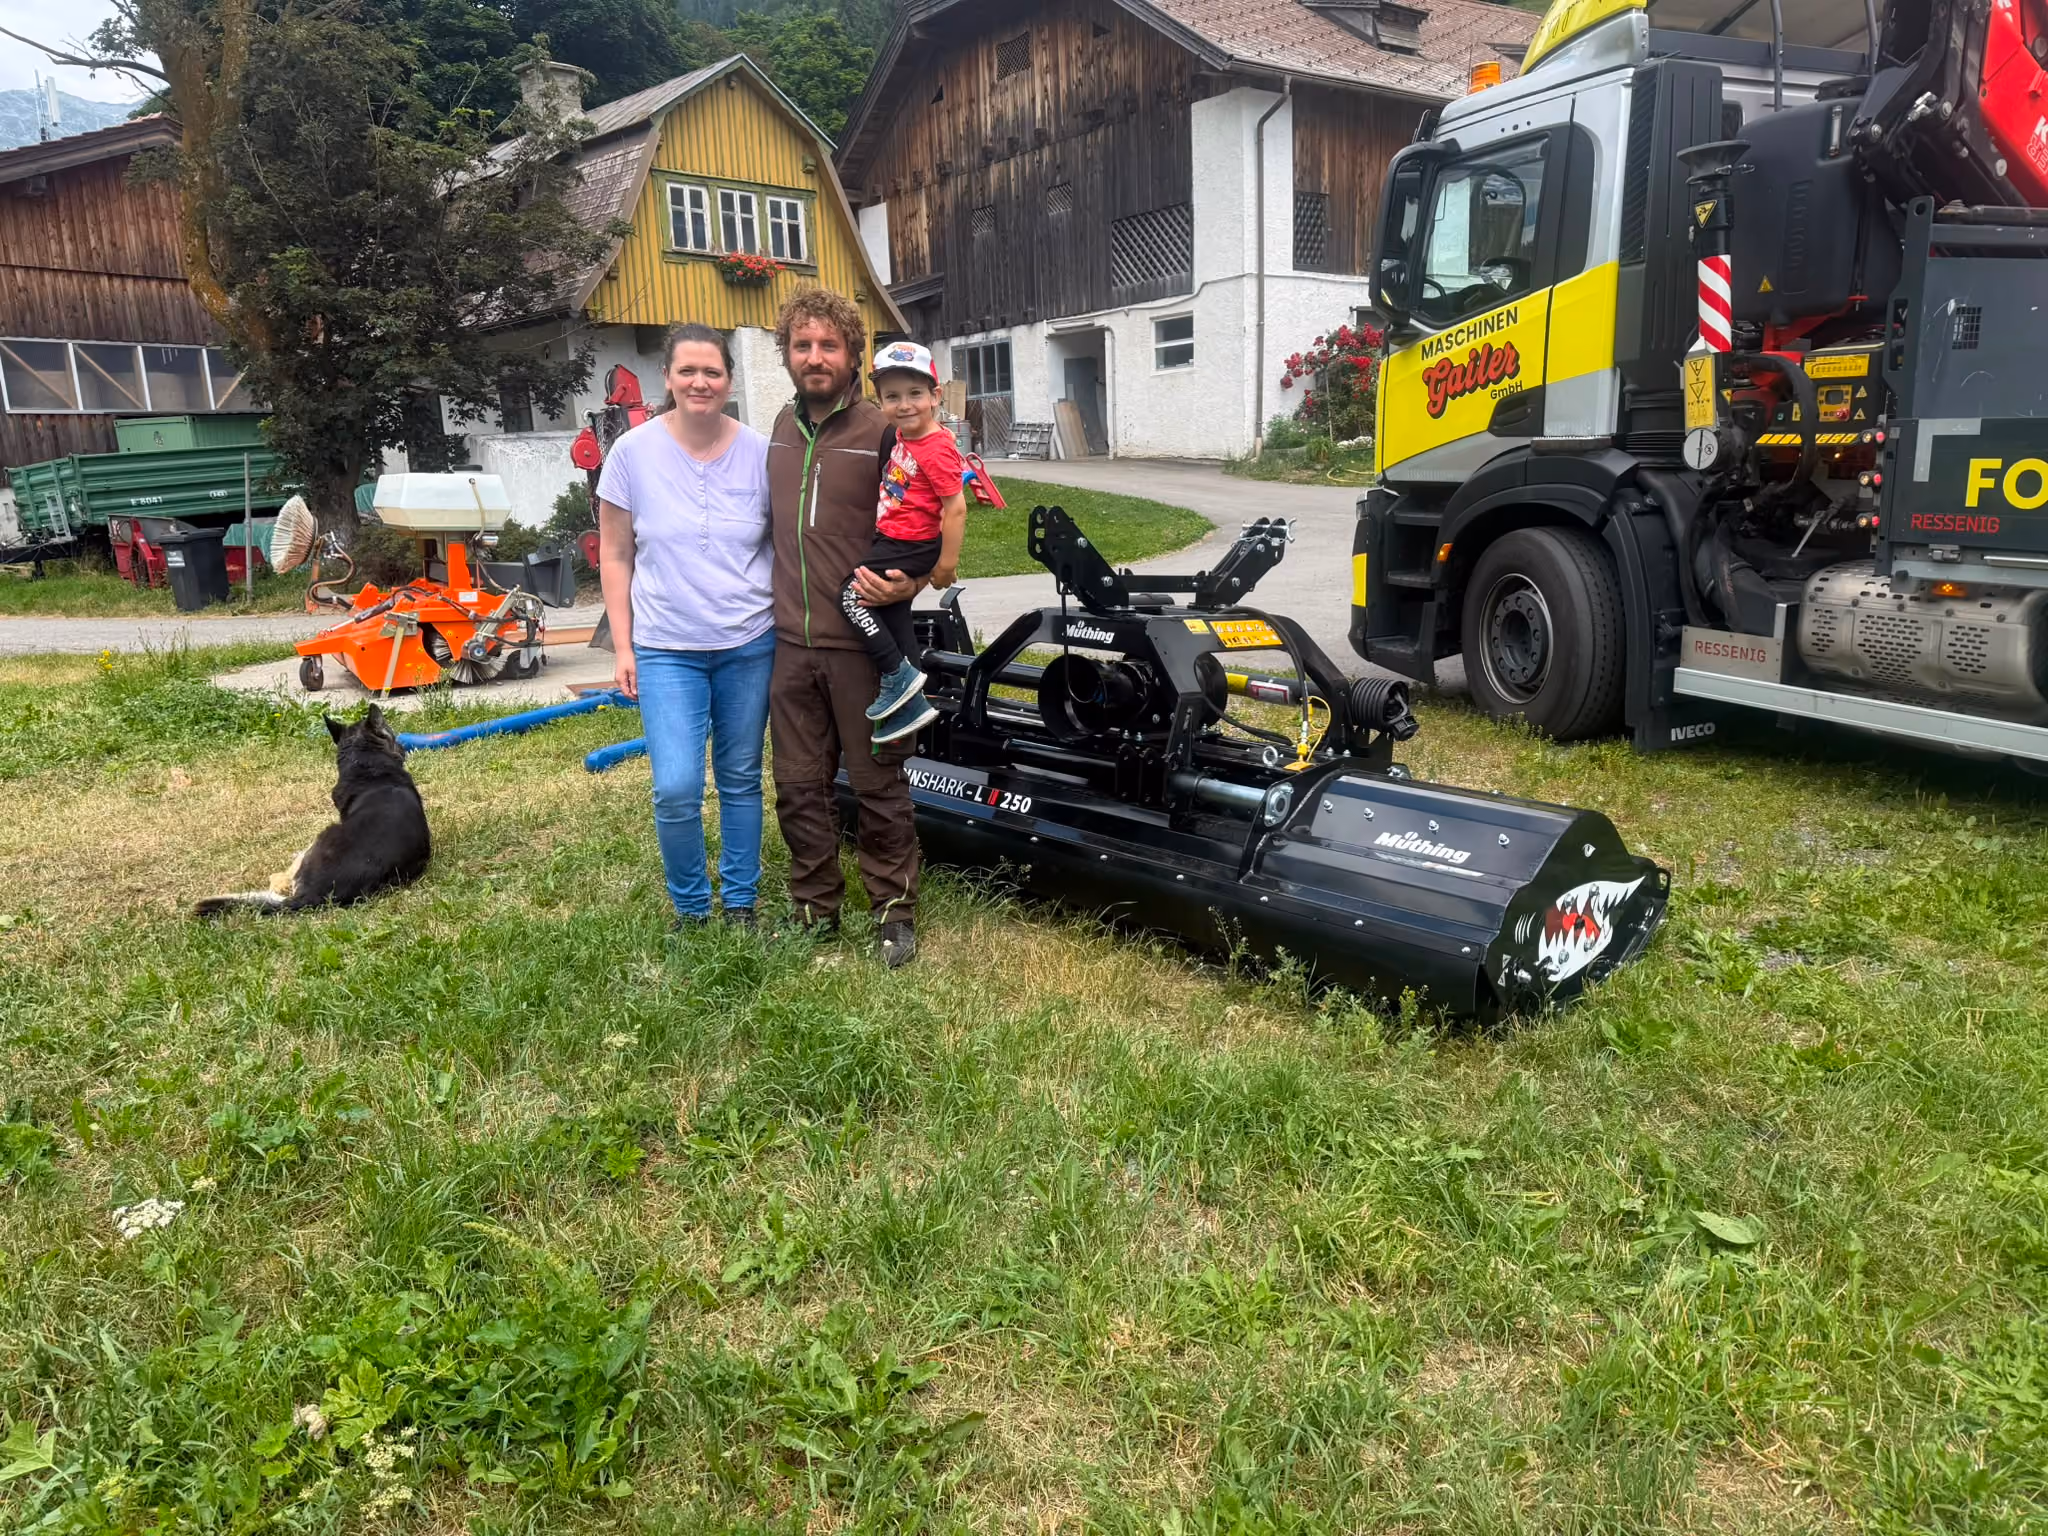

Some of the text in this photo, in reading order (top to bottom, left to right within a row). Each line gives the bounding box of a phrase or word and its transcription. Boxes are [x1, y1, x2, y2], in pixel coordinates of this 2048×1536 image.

[1421, 306, 1519, 361] MASCHINEN
[1422, 340, 1520, 420] Gailer
[1490, 380, 1523, 400] GmbH
[1910, 513, 2001, 534] RESSENIG
[1695, 640, 1767, 663] RESSENIG
[1671, 722, 1716, 742] IVECO
[999, 791, 1032, 814] 250
[1373, 831, 1472, 865] Müthing
